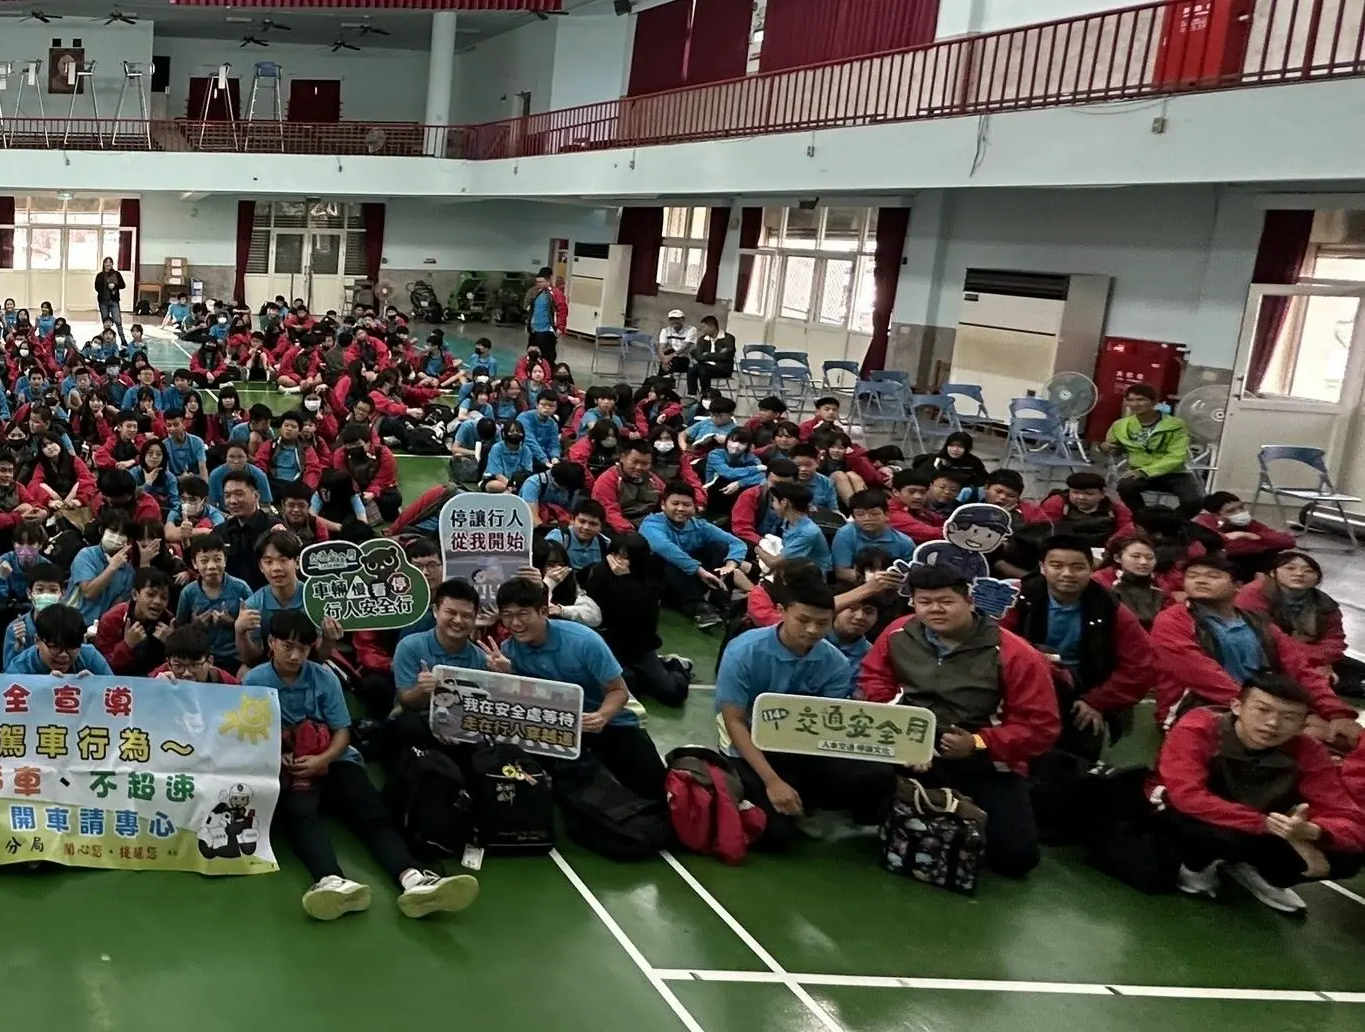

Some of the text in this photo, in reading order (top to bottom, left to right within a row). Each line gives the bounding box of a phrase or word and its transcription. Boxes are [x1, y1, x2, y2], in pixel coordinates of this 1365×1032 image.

[450, 509, 524, 528] 停讓行人
[450, 532, 524, 551] 從我開始
[323, 595, 414, 620] 行人安全行
[463, 696, 575, 728] 我在安全處等待
[795, 705, 930, 745] 交通安全月
